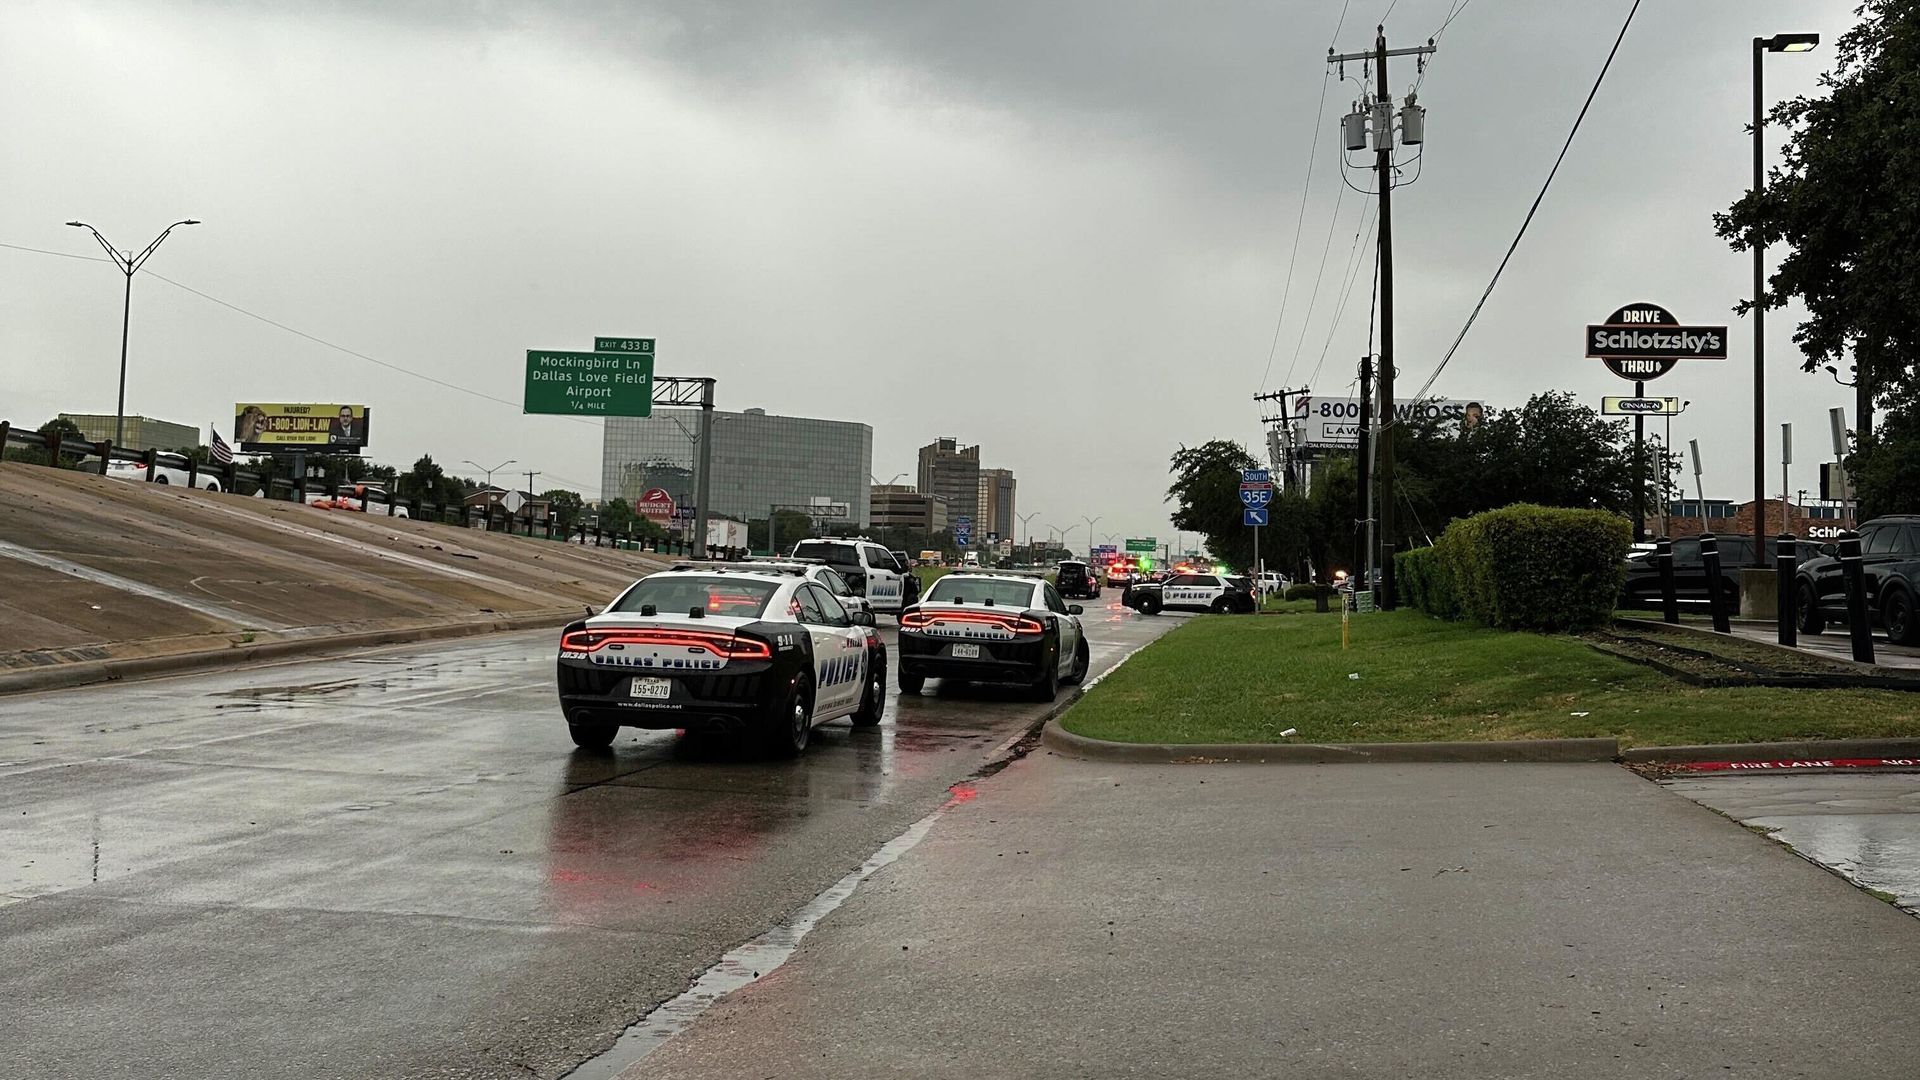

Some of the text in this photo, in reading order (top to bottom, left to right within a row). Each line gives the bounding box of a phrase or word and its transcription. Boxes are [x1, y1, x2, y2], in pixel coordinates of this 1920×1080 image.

[1623, 310, 1661, 323] DRIVE
[1595, 330, 1721, 353] Schlotzsky's
[540, 356, 640, 370] Mockingbird Ln
[1620, 360, 1655, 373] THRU
[533, 370, 646, 384] Dallas Love Field
[566, 386, 612, 398] Airport
[284, 406, 311, 414] INJURED?
[587, 402, 605, 410] MILE
[268, 417, 331, 431] 1-800-LION-LAW
[1326, 427, 1359, 435] LAW
[1244, 472, 1268, 481] SOUTH
[1243, 491, 1268, 503] 35E
[560, 652, 588, 660] 1038
[595, 655, 720, 669] DALLAS POLICE
[818, 653, 860, 689] POLICE
[1730, 761, 1773, 769] FIRE
[1778, 760, 1835, 768] LANE
